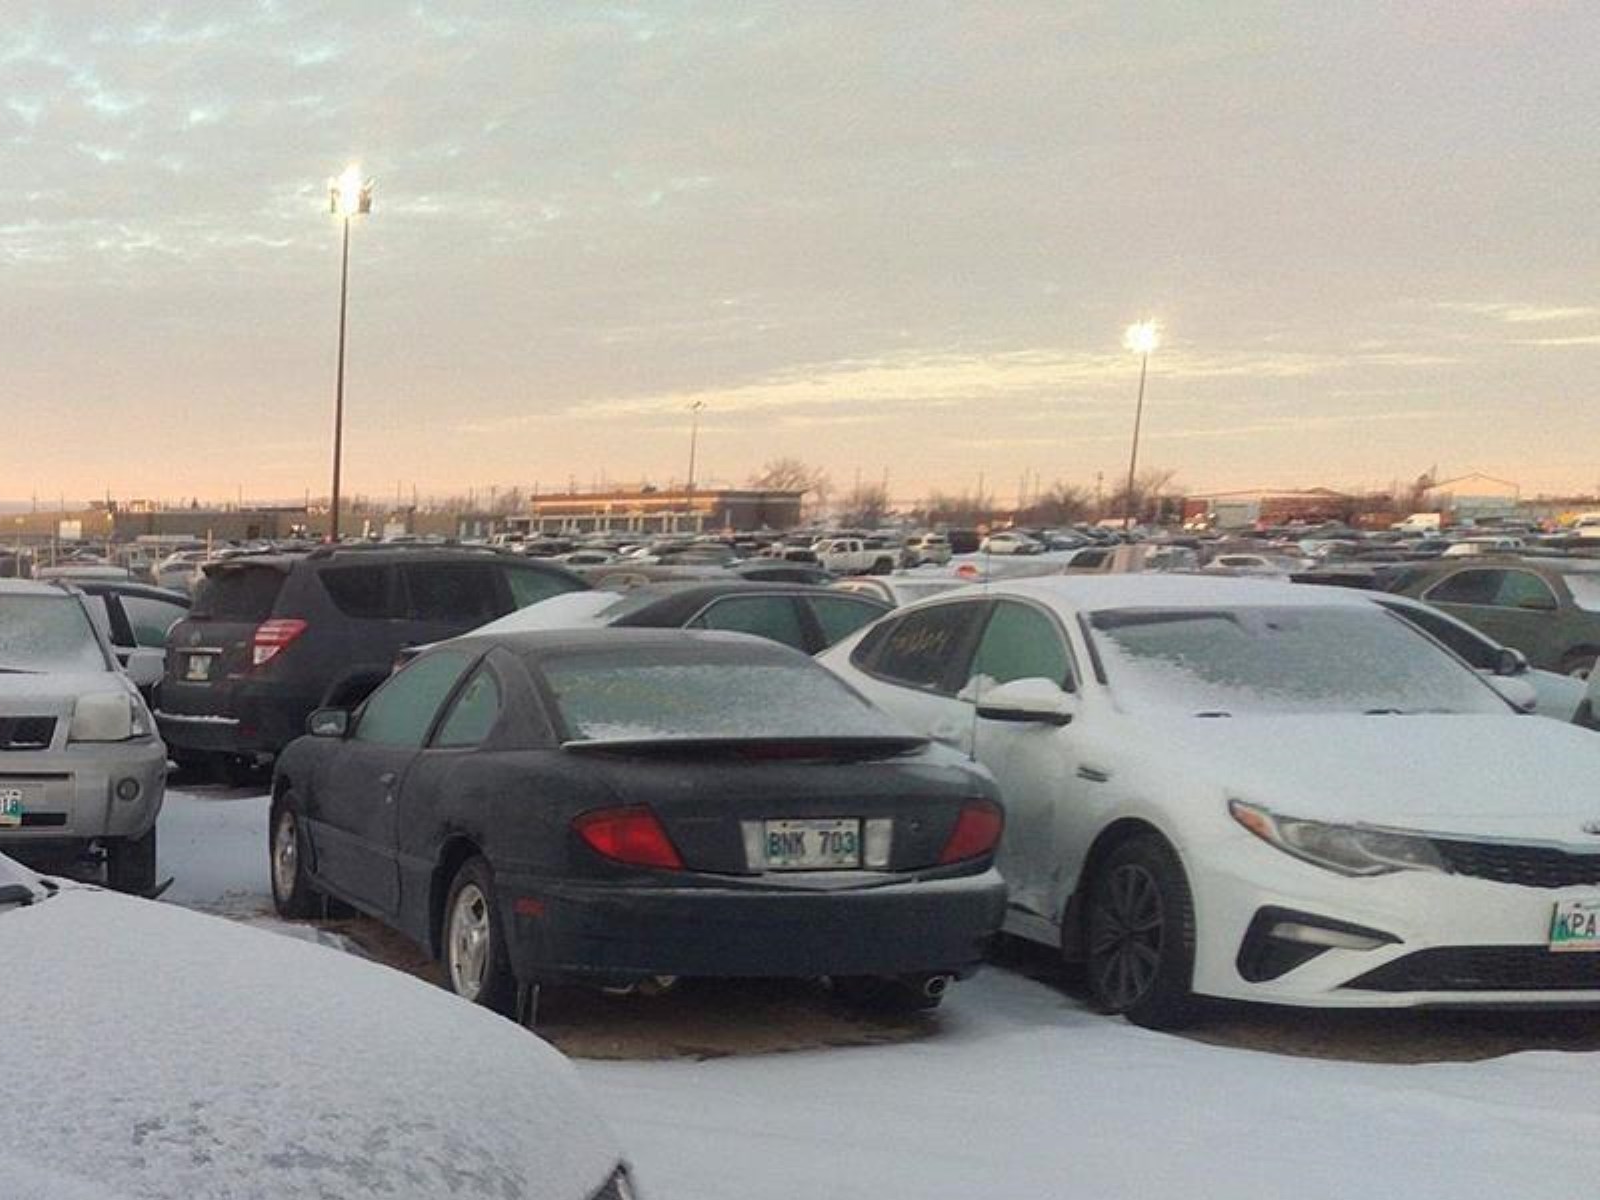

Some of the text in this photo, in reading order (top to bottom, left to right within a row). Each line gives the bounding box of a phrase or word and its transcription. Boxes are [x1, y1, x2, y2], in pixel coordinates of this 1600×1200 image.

[767, 830, 855, 856] BNK 703
[1558, 912, 1596, 938] KPA
